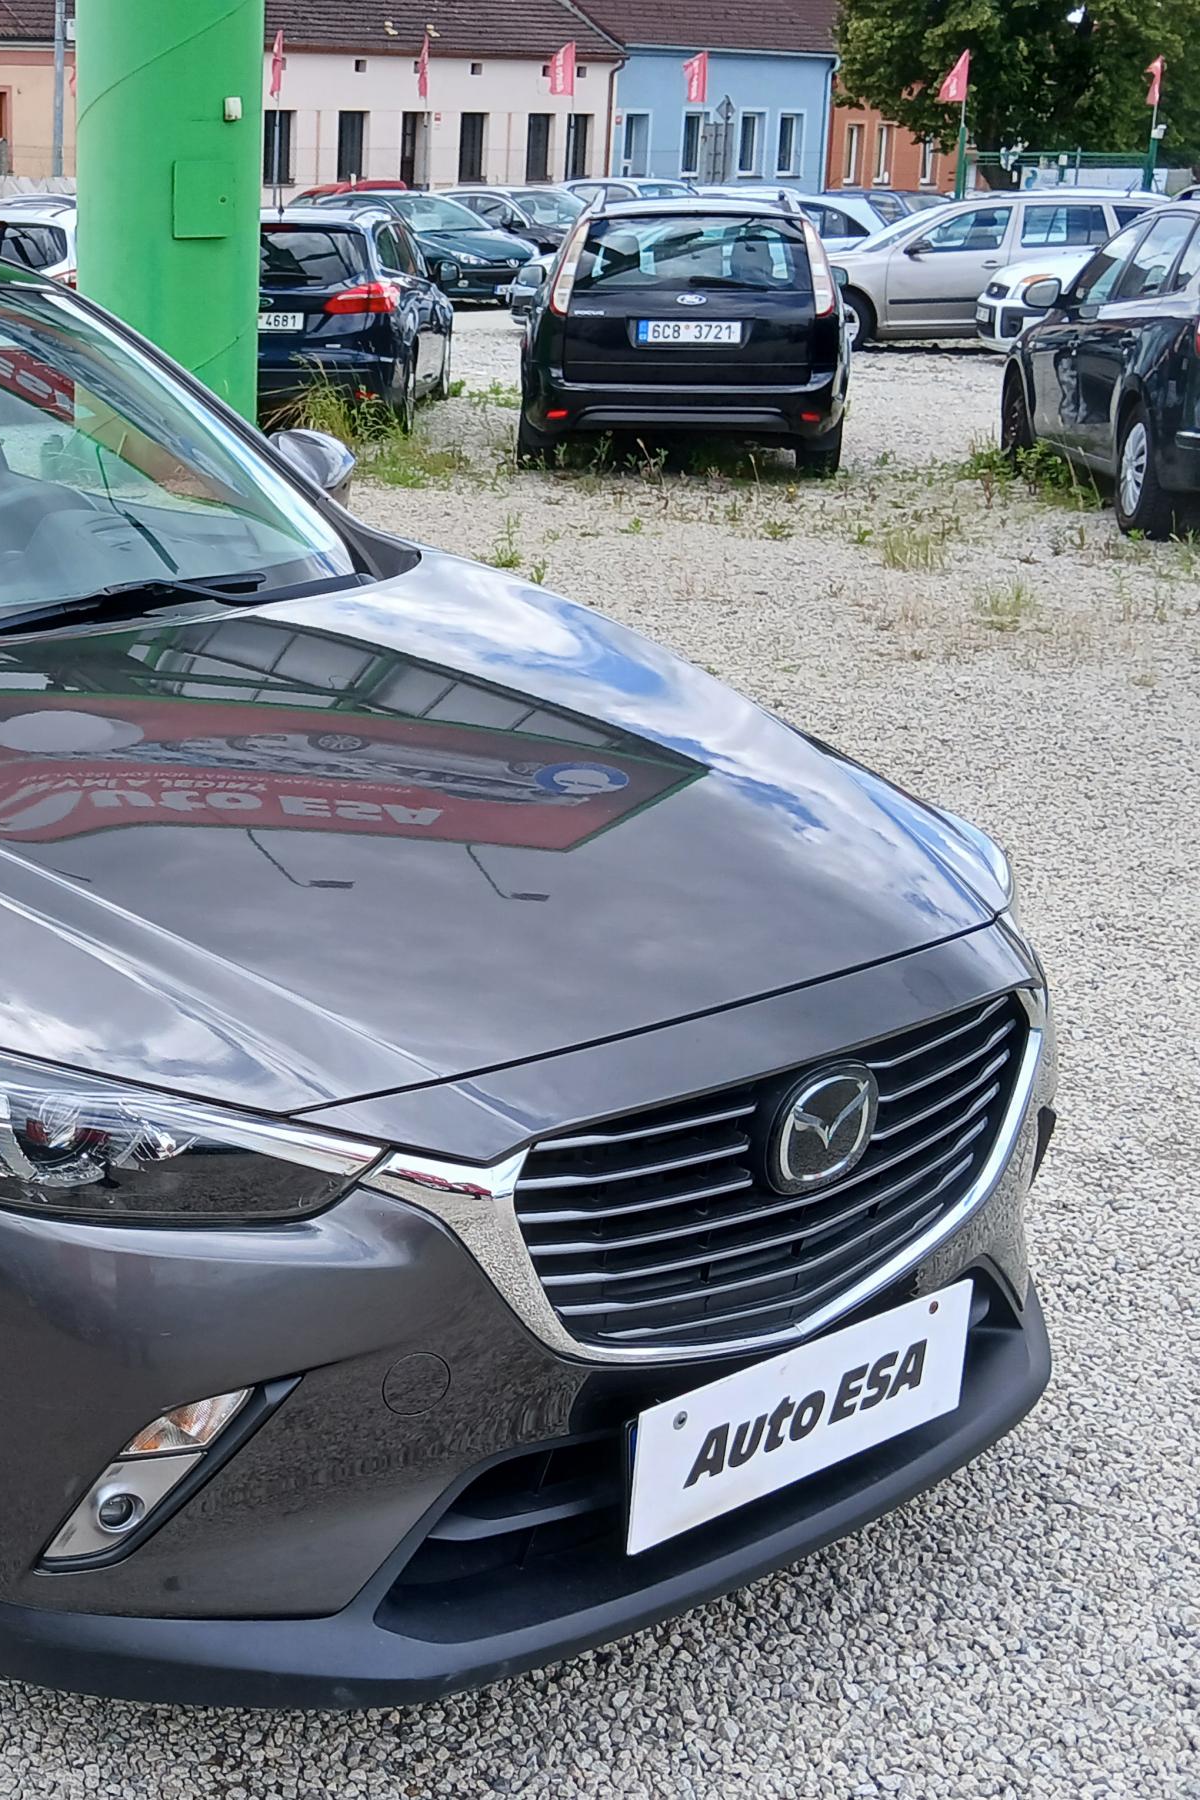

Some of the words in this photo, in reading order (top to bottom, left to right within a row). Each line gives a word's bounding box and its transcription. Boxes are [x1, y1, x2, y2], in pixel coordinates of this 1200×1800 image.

[265, 314, 298, 328] 4681
[651, 324, 681, 340] 6C8
[694, 324, 733, 340] 3721
[683, 1389, 825, 1489] Auto
[827, 1338, 928, 1426] ESA
